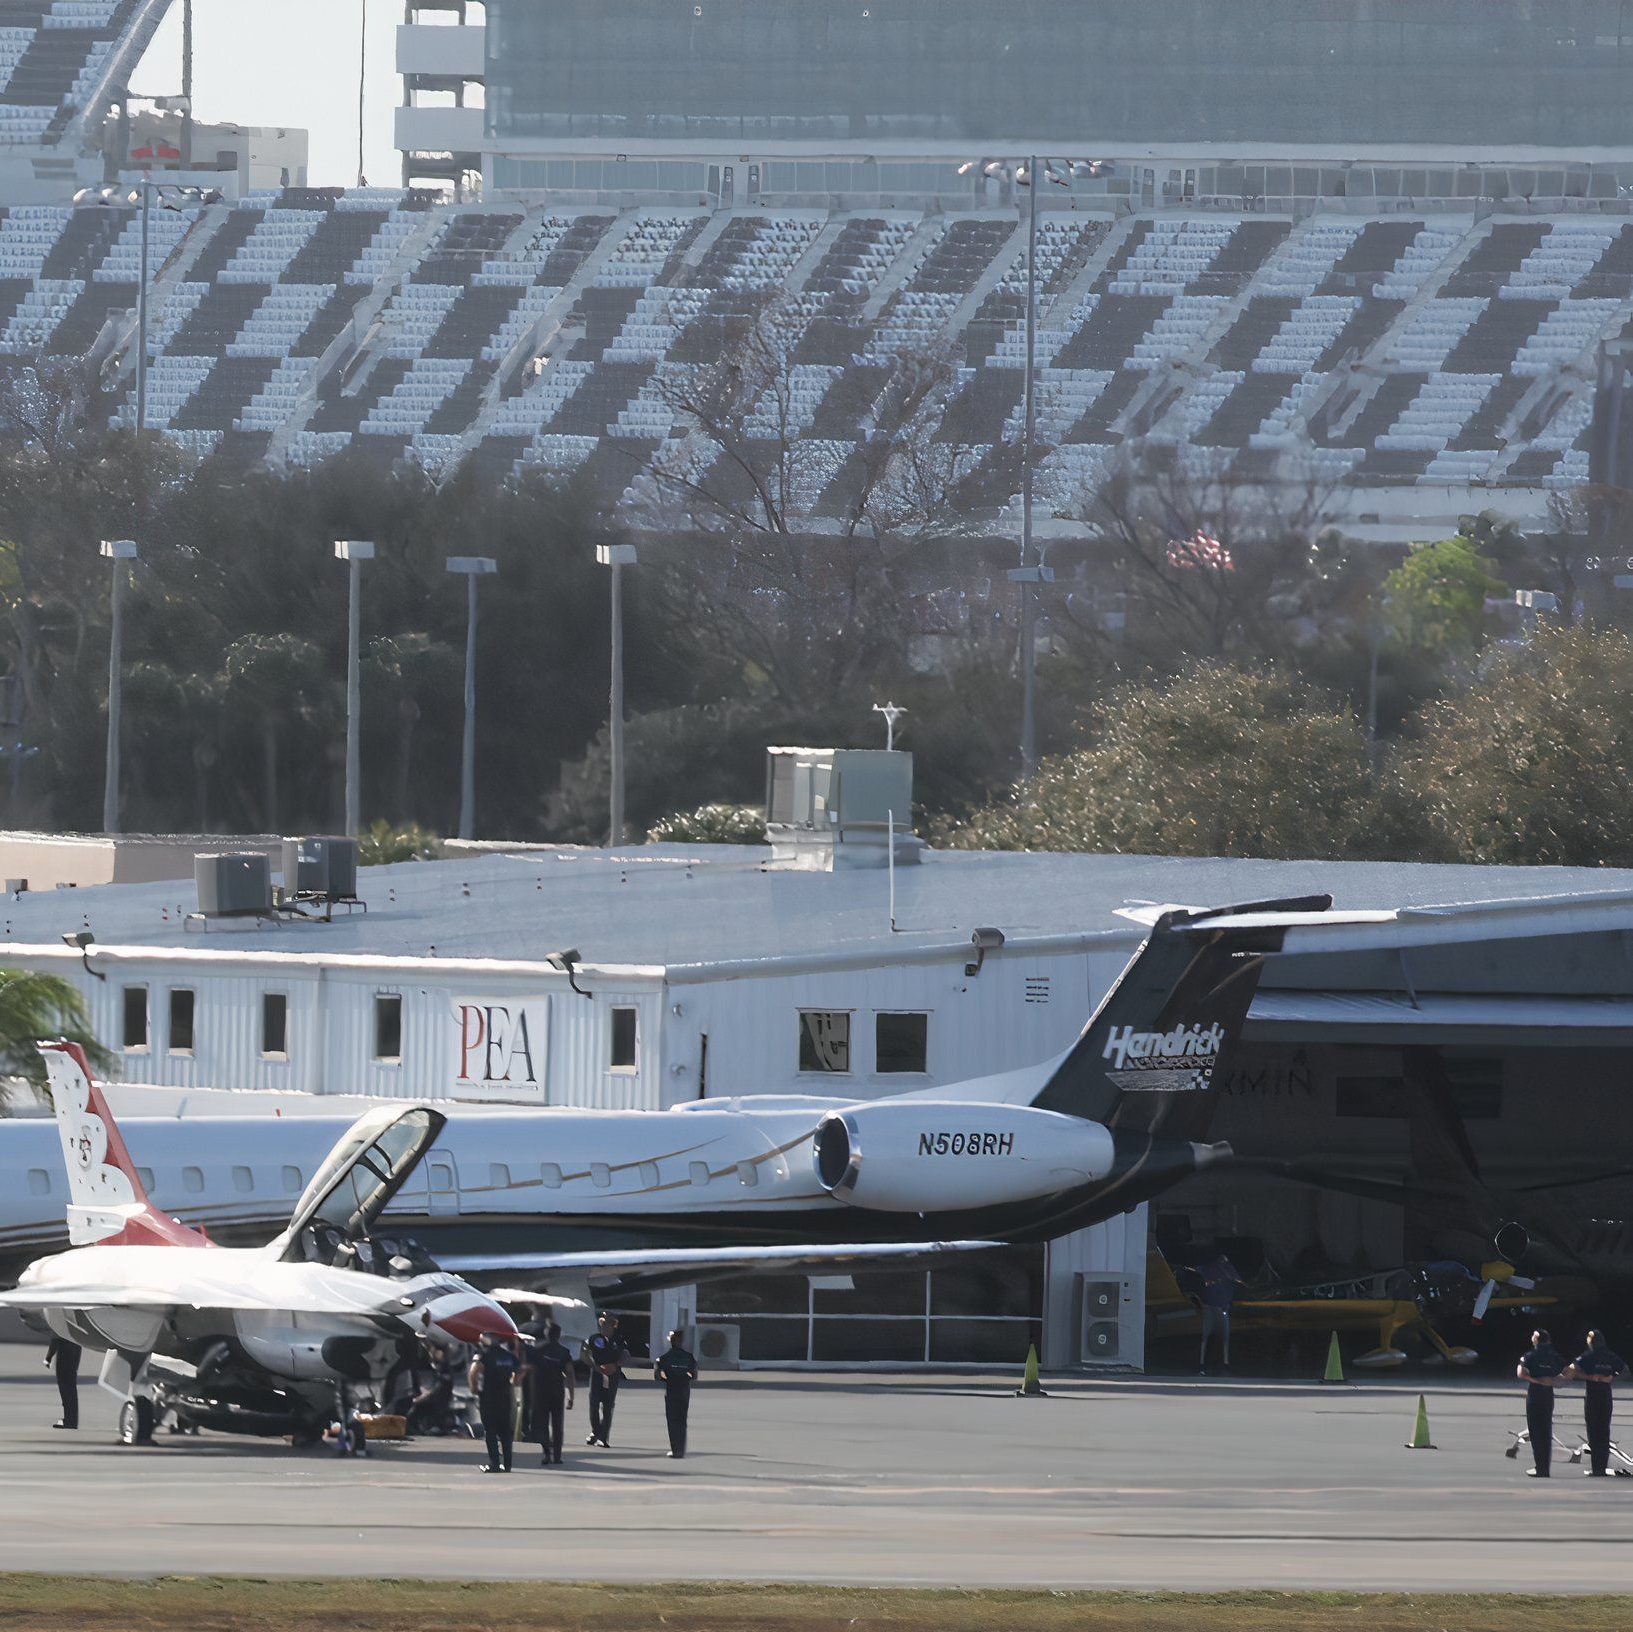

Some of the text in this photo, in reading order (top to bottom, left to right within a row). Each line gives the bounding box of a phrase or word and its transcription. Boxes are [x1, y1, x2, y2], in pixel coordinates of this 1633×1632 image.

[457, 1005, 537, 1082] PEA
[1102, 1022, 1225, 1070] Hendrick
[918, 1132, 1015, 1156] N508RH
